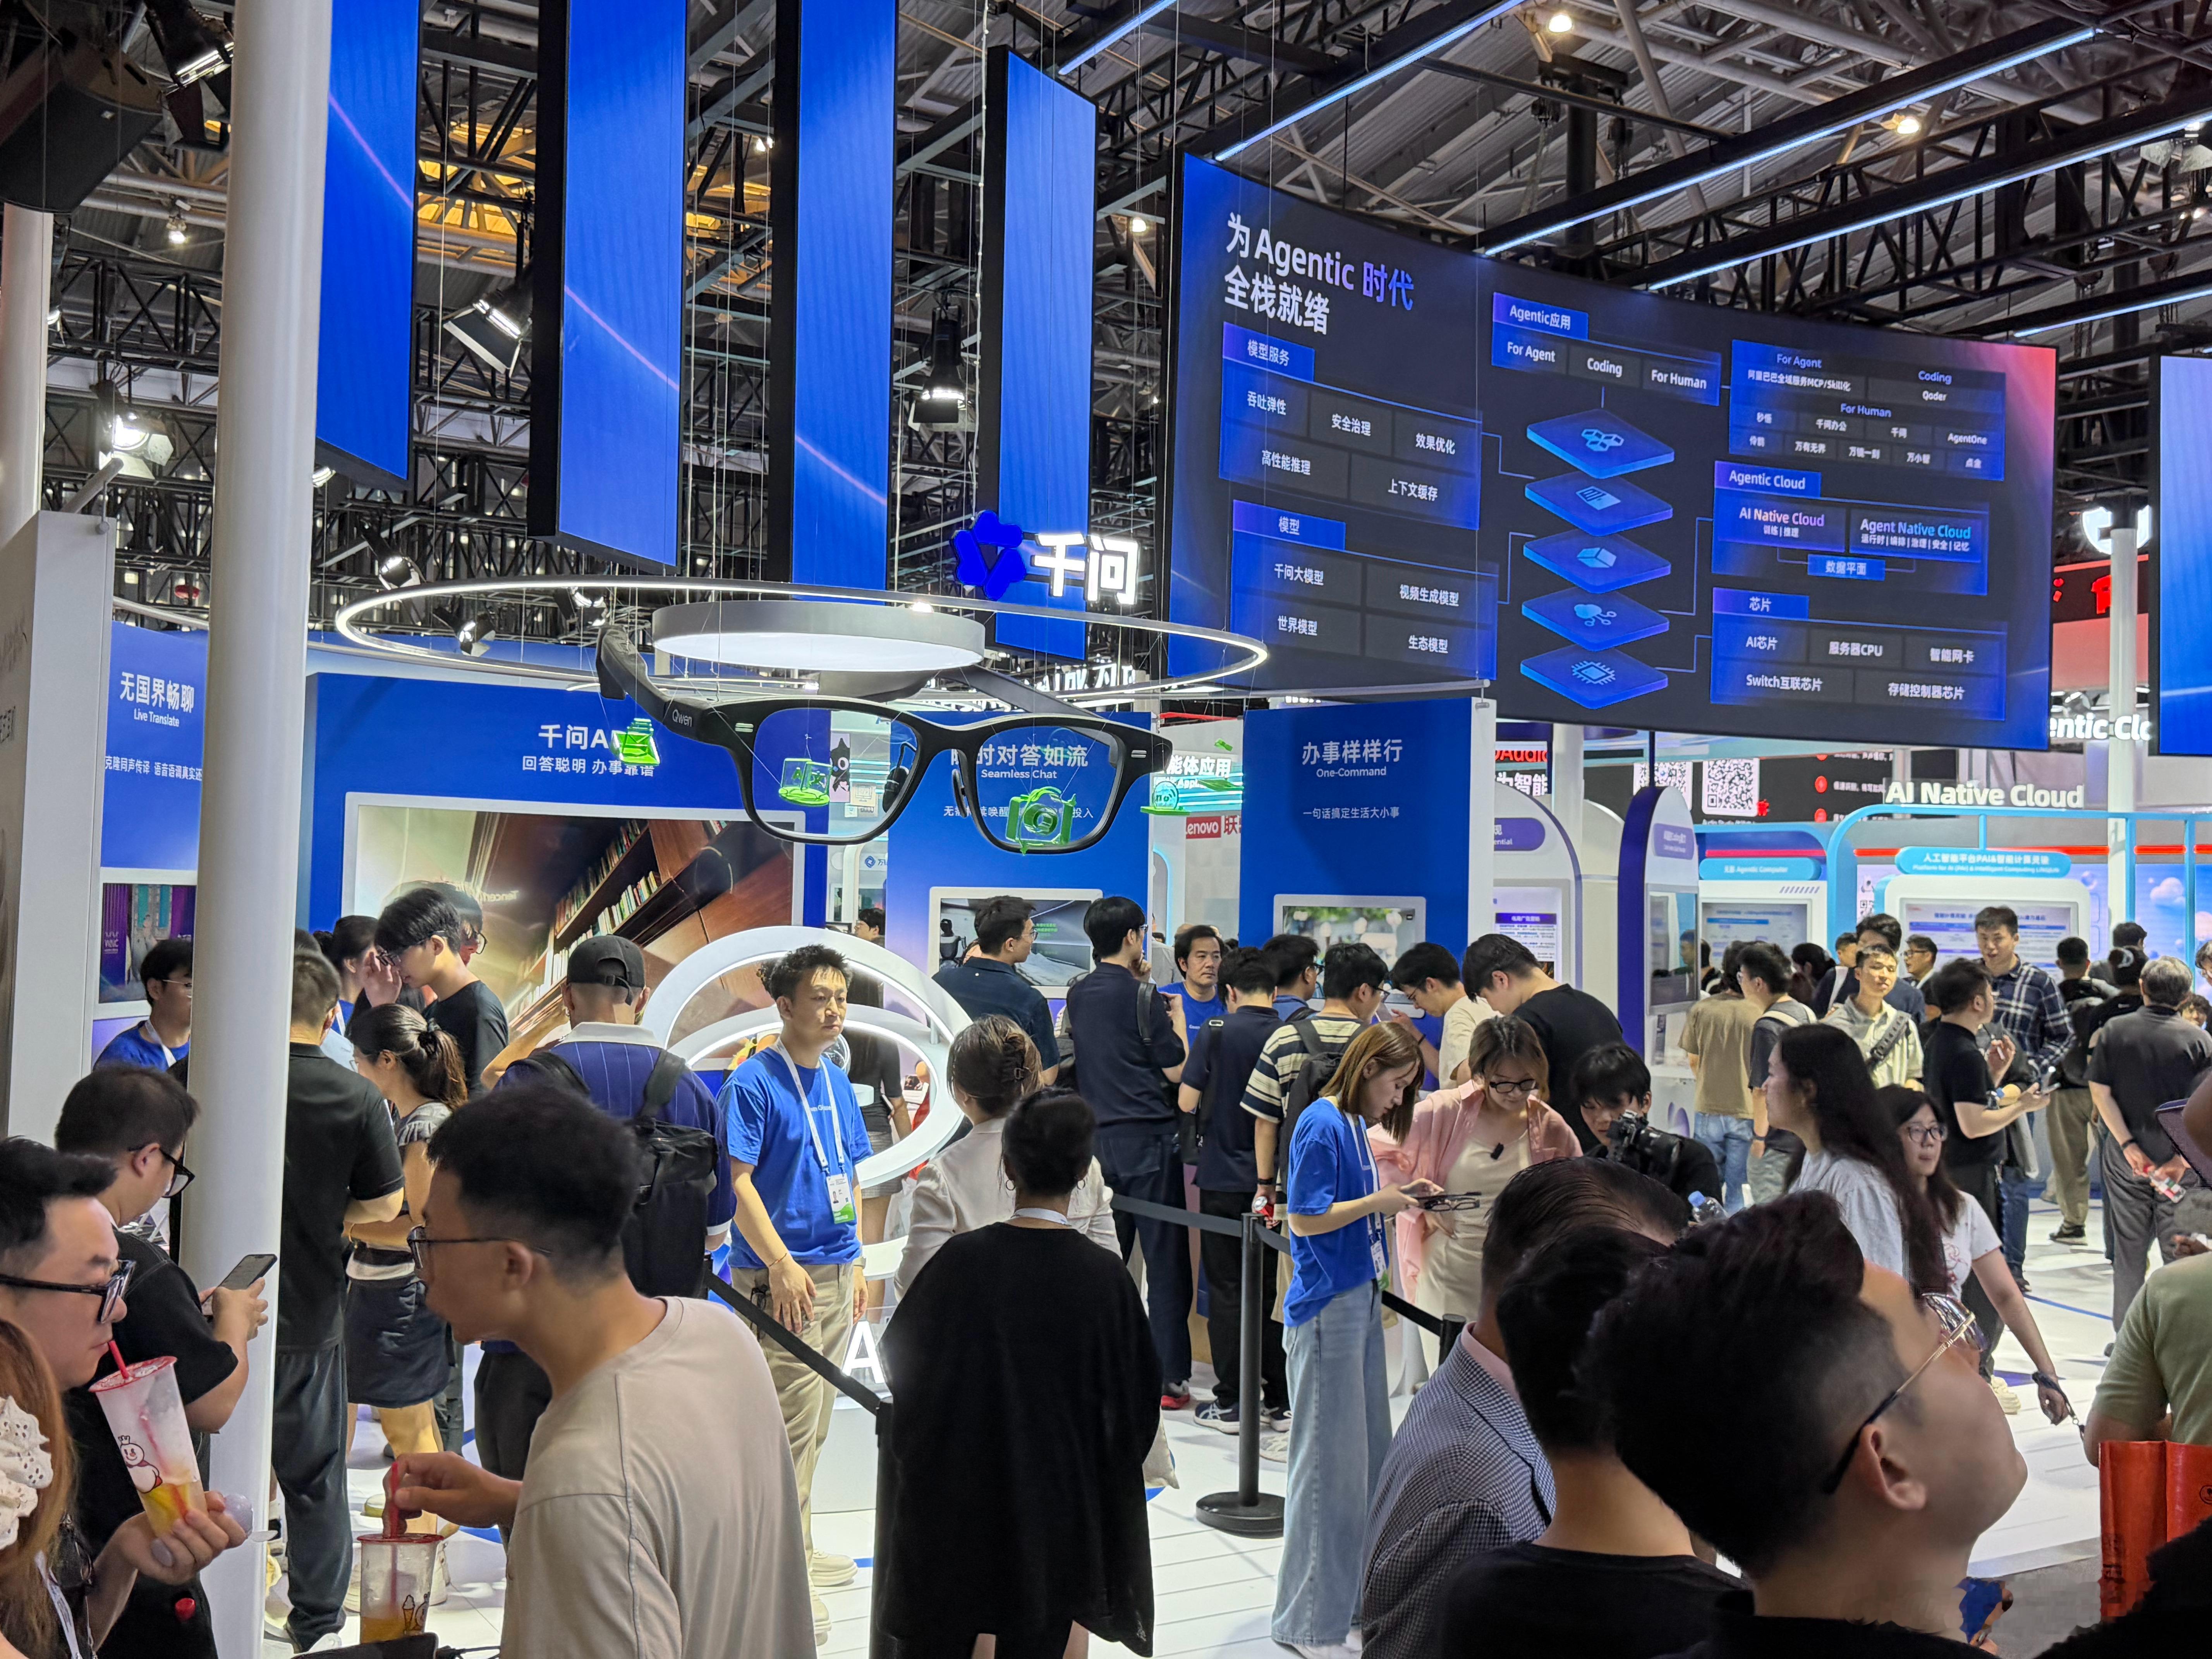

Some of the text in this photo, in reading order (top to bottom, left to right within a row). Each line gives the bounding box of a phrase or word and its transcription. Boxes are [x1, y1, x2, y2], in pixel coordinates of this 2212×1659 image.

[1226, 212, 1414, 310] 为 Agentic 时代
[1224, 265, 1329, 335] 全栈就绪
[1510, 305, 1571, 330] Agentic应用
[1247, 339, 1290, 367] 模型服务
[1507, 341, 1556, 363] For Agent
[1777, 353, 1822, 368] For Agent
[1587, 358, 1623, 378] Coding
[1918, 371, 1952, 385] Coding
[1651, 369, 1707, 389] For Human
[1247, 391, 1286, 416] 吞吐弹性
[1922, 390, 1947, 401] Qoder
[1840, 403, 1892, 418] For Human
[1331, 414, 1371, 436] 安全治理
[1415, 433, 1456, 455] 效果优化
[1948, 433, 1987, 445] AgentOne
[1261, 450, 1311, 476] 高性能推理
[1388, 479, 1438, 501] 上下文缓存
[1729, 471, 1805, 489] Agentic Cloud
[1278, 516, 1300, 536] 模型
[1739, 507, 1825, 527] AI Native Cloud
[1860, 519, 1971, 539] Agent Native Cloud
[1032, 533, 1138, 605] 千问
[1274, 564, 1324, 586] 千问大模型
[1826, 561, 1867, 576] 数据平面
[1400, 584, 1459, 607] 视频生成模型
[1749, 597, 1771, 612] 芯片
[1278, 616, 1317, 636] 世界模型
[1408, 635, 1448, 654] 生态模型
[1746, 636, 1778, 650] AI芯片
[1829, 641, 1883, 657] 服务器CPU
[1930, 648, 1974, 663] 智能网卡
[120, 672, 194, 713] 无国界畅聊
[1746, 674, 1823, 692] Switch互联芯片
[1888, 682, 1965, 700] 存储控制器芯片
[134, 708, 179, 727] Live Translate
[672, 709, 692, 727] Qwen
[538, 724, 623, 750] 千问A
[1302, 738, 1403, 765] 办事样样行
[523, 755, 586, 773] 回答聪明
[981, 769, 1057, 778] Seamless Chat
[1316, 766, 1386, 778] One-Command
[1886, 781, 1912, 803] AI
[1920, 783, 2004, 806] Native
[2010, 783, 2084, 808] Cloud
[1304, 806, 1400, 819] 一句话搞定生活大小事
[1186, 821, 1219, 835] enovo
[1224, 815, 1241, 835] 联
